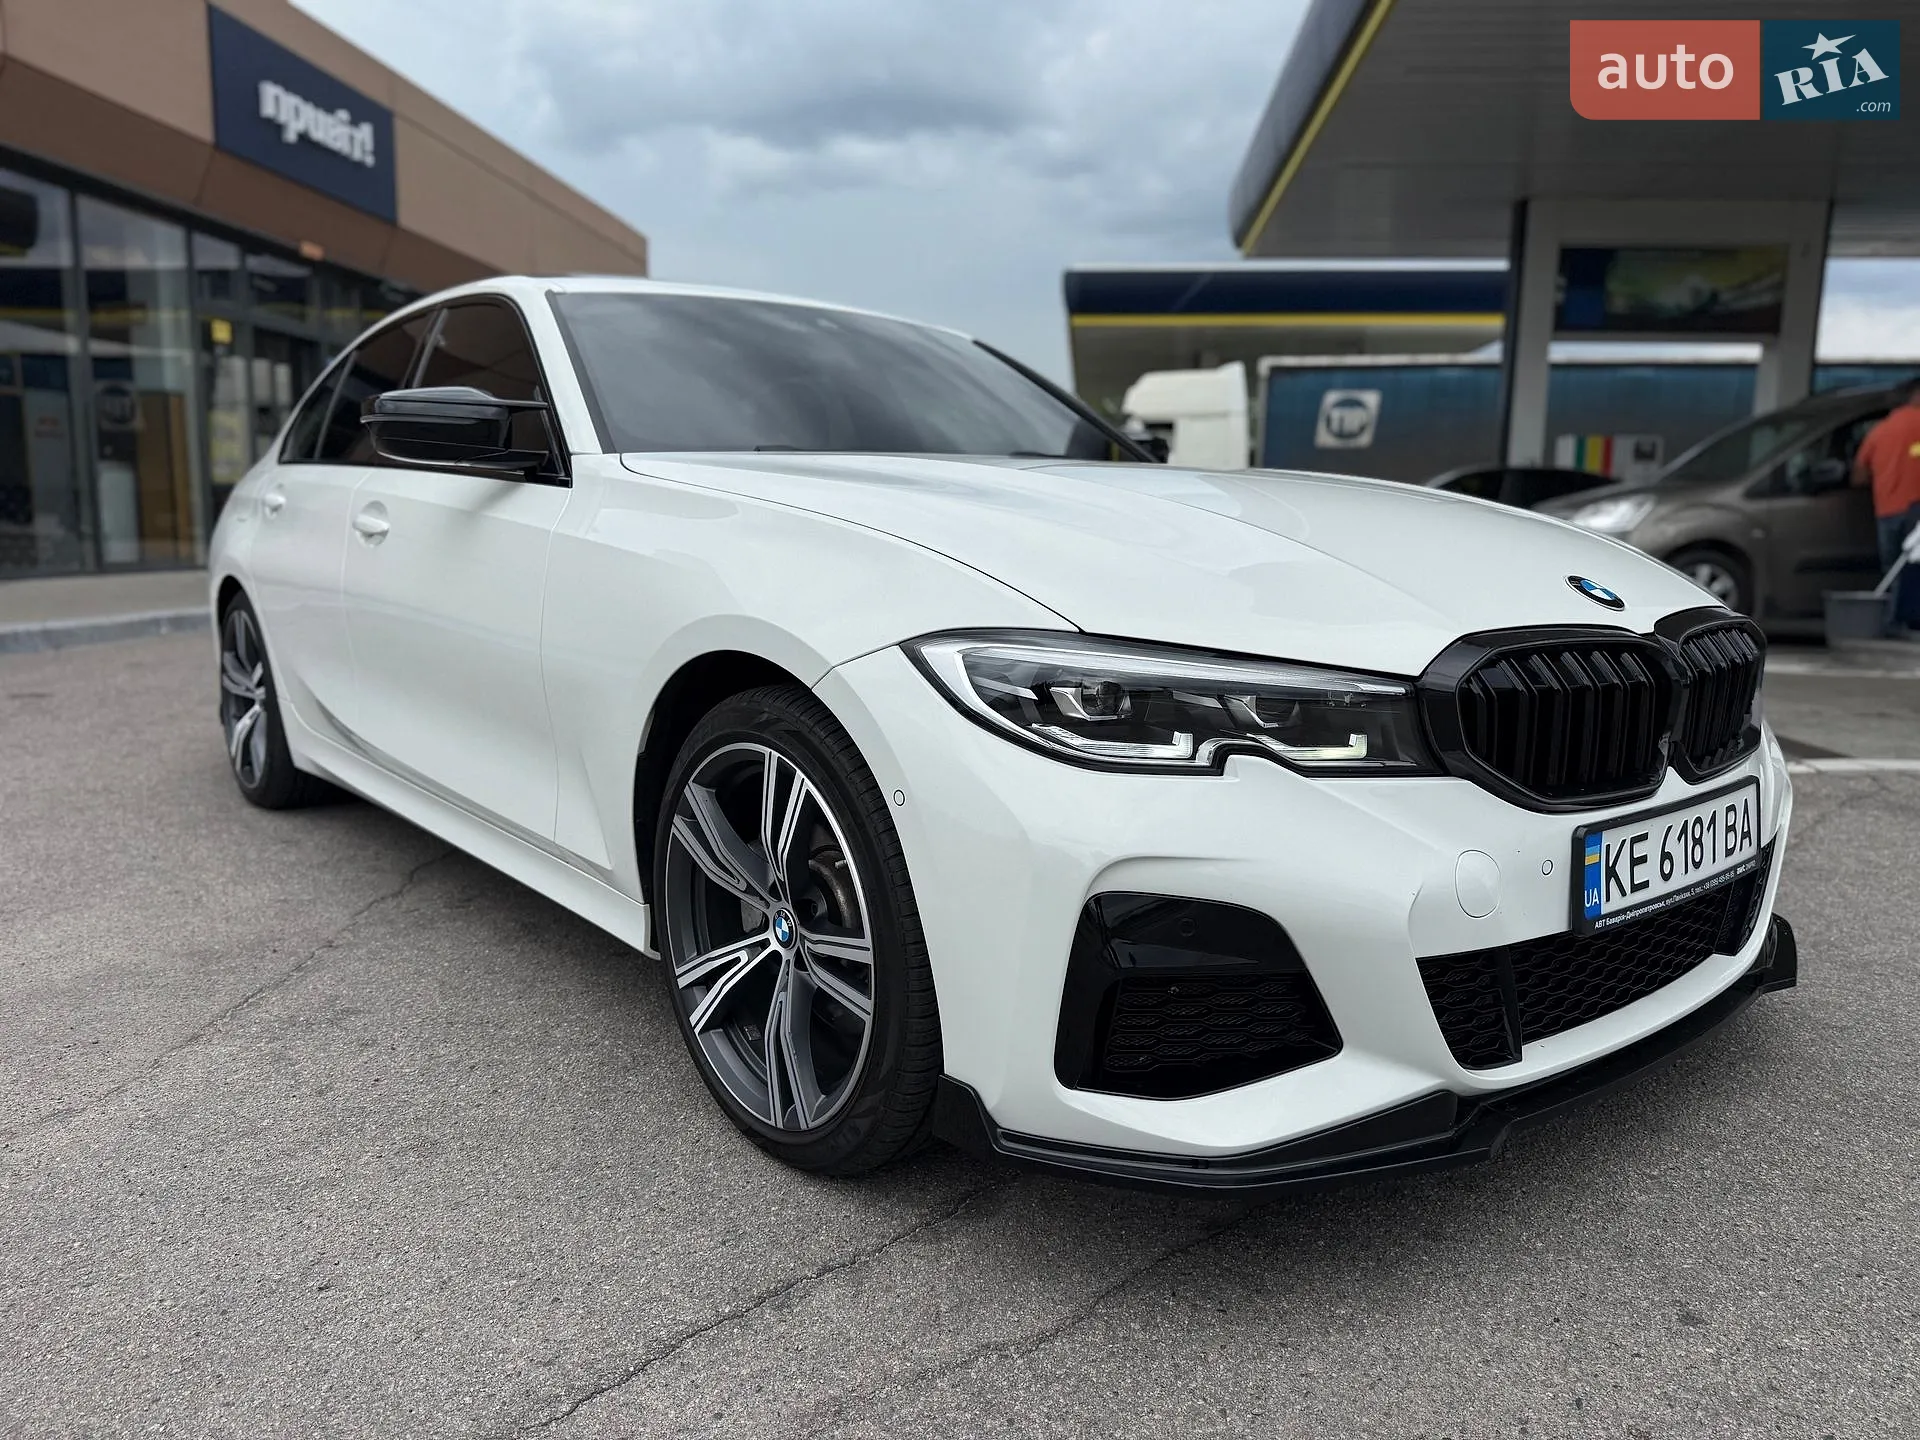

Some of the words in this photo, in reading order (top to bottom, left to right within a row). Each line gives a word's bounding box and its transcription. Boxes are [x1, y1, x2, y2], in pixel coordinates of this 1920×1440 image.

[1605, 831, 1650, 903] KE
[1659, 809, 1717, 882] 6181
[1724, 797, 1753, 858] BA
[1584, 887, 1600, 908] UA
